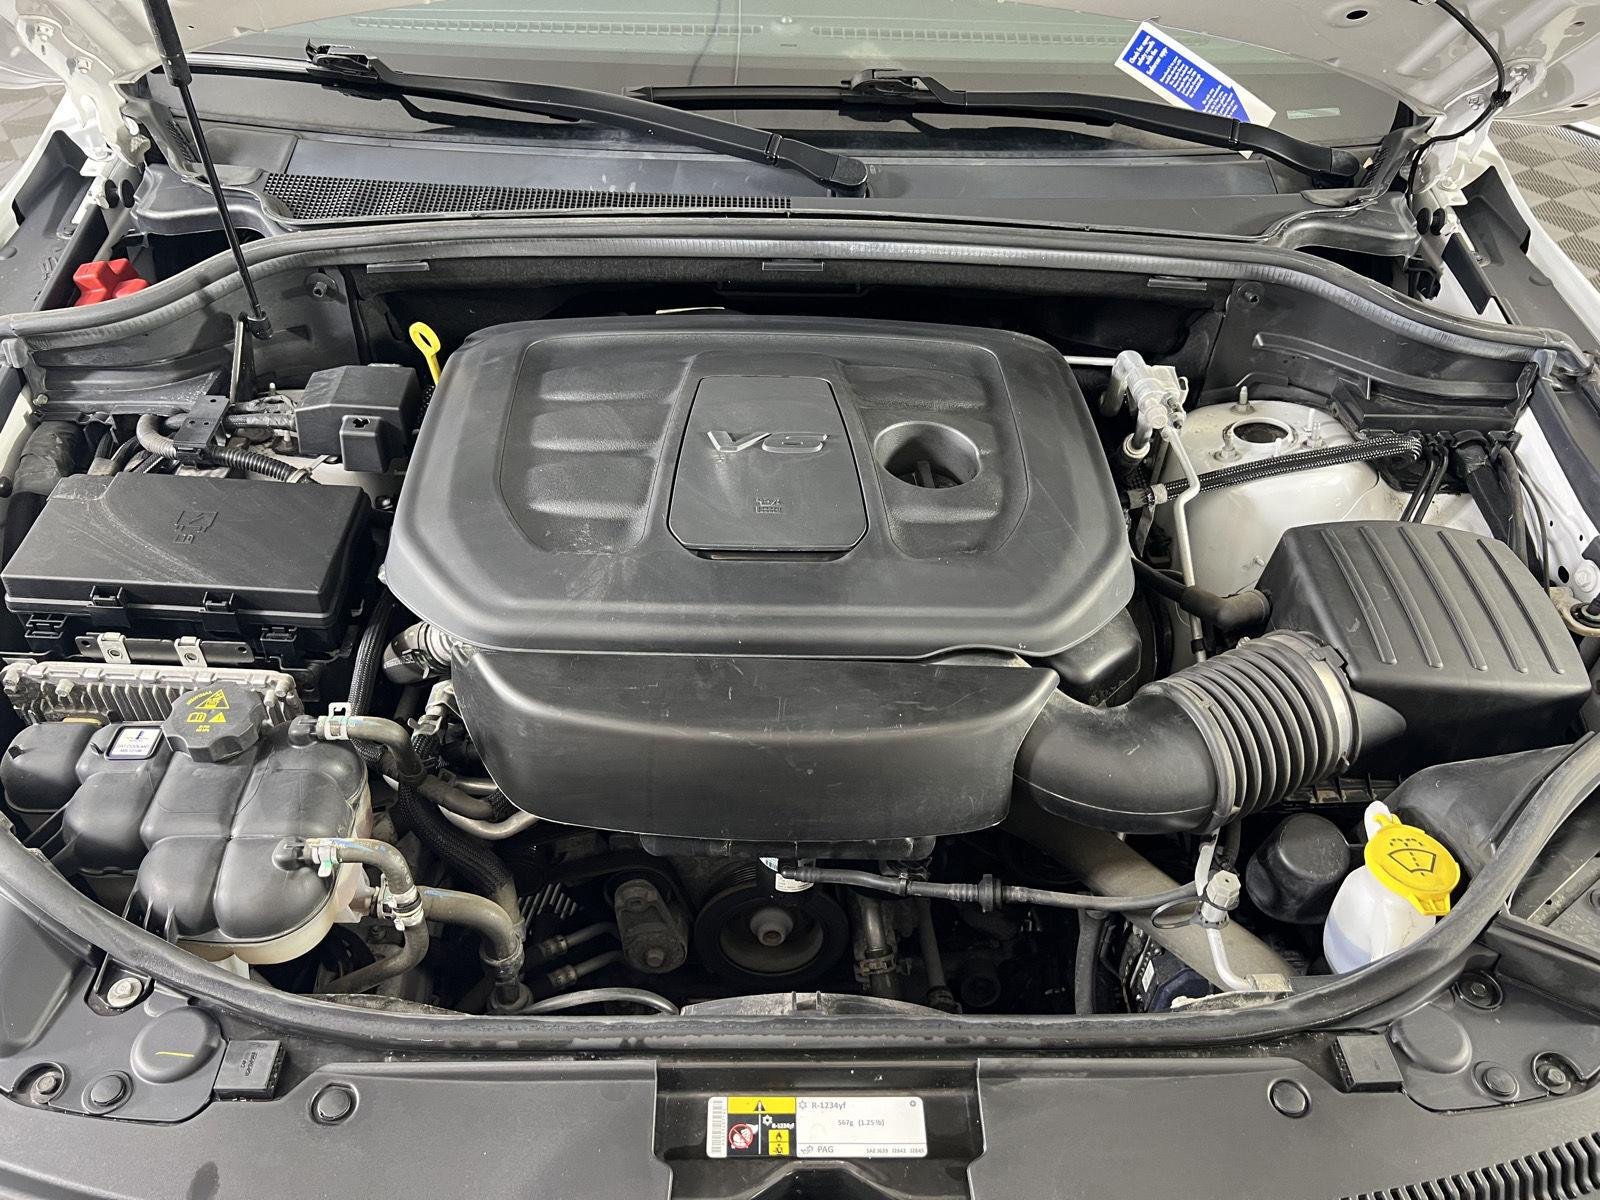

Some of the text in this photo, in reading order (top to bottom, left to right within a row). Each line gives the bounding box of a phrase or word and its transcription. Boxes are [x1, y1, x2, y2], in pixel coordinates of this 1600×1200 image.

[706, 430, 828, 454] V6
[811, 1101, 847, 1111] R-1234yf
[837, 1119, 854, 1127] 567g
[817, 1145, 834, 1153] PAG
